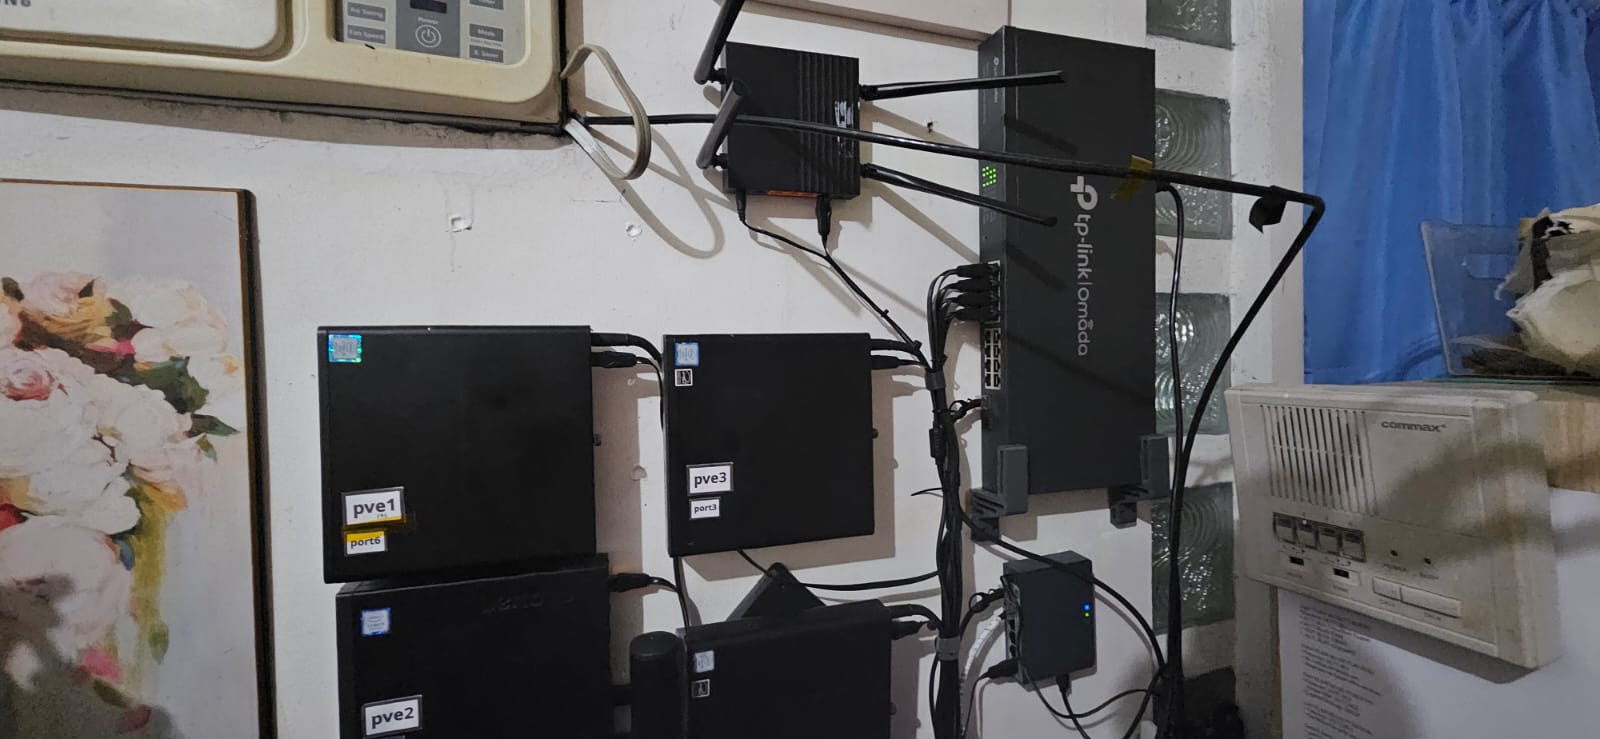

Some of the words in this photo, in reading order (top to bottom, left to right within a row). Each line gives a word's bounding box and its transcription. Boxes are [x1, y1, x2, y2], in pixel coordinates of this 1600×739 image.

[1073, 213, 1094, 279] tp-link
[1381, 421, 1442, 433] commax
[694, 472, 727, 488] pve3
[353, 498, 395, 518] pve1
[694, 503, 717, 514] port3
[350, 537, 381, 549] port6
[371, 706, 414, 729] pve2
